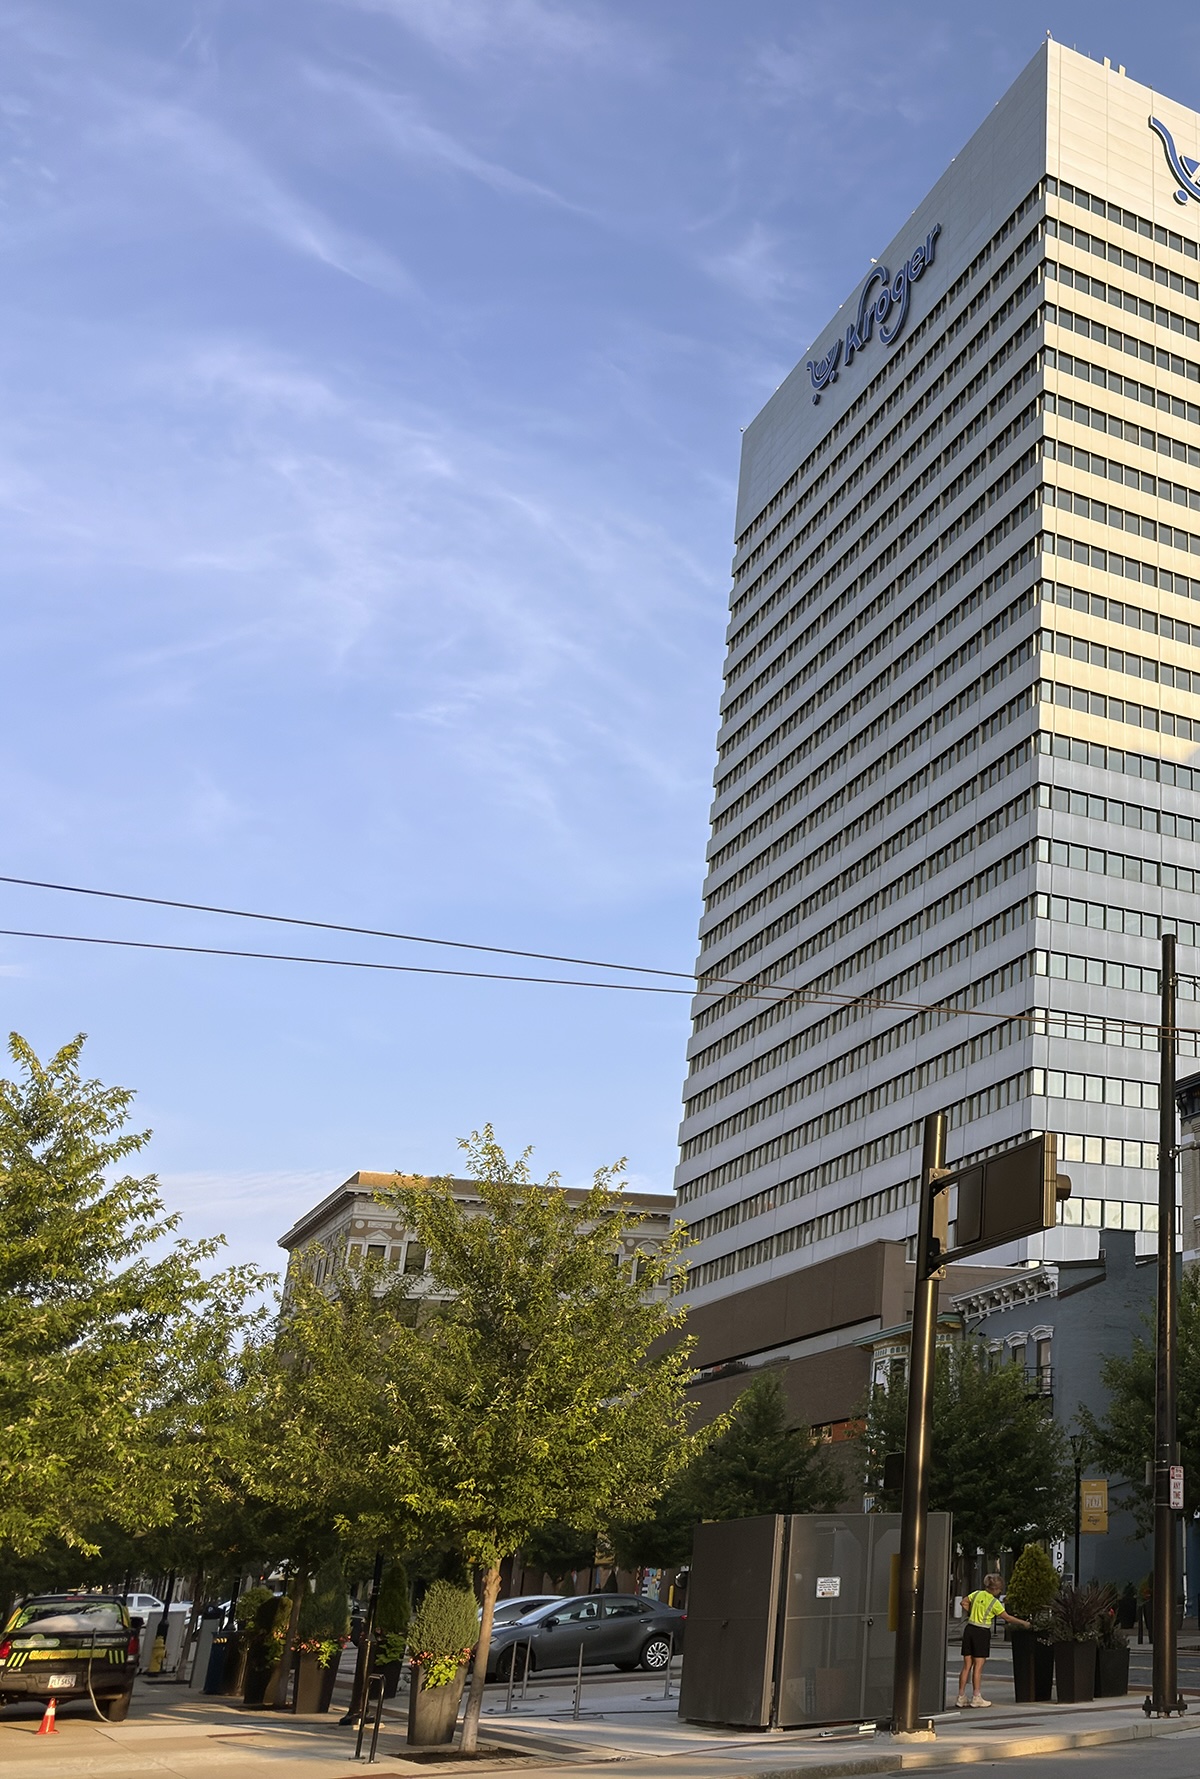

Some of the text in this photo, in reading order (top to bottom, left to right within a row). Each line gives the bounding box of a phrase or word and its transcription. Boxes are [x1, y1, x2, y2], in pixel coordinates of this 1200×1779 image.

[844, 223, 942, 367] Kroger
[1173, 1481, 1181, 1490] ANY
[1173, 1490, 1181, 1500] TIME
